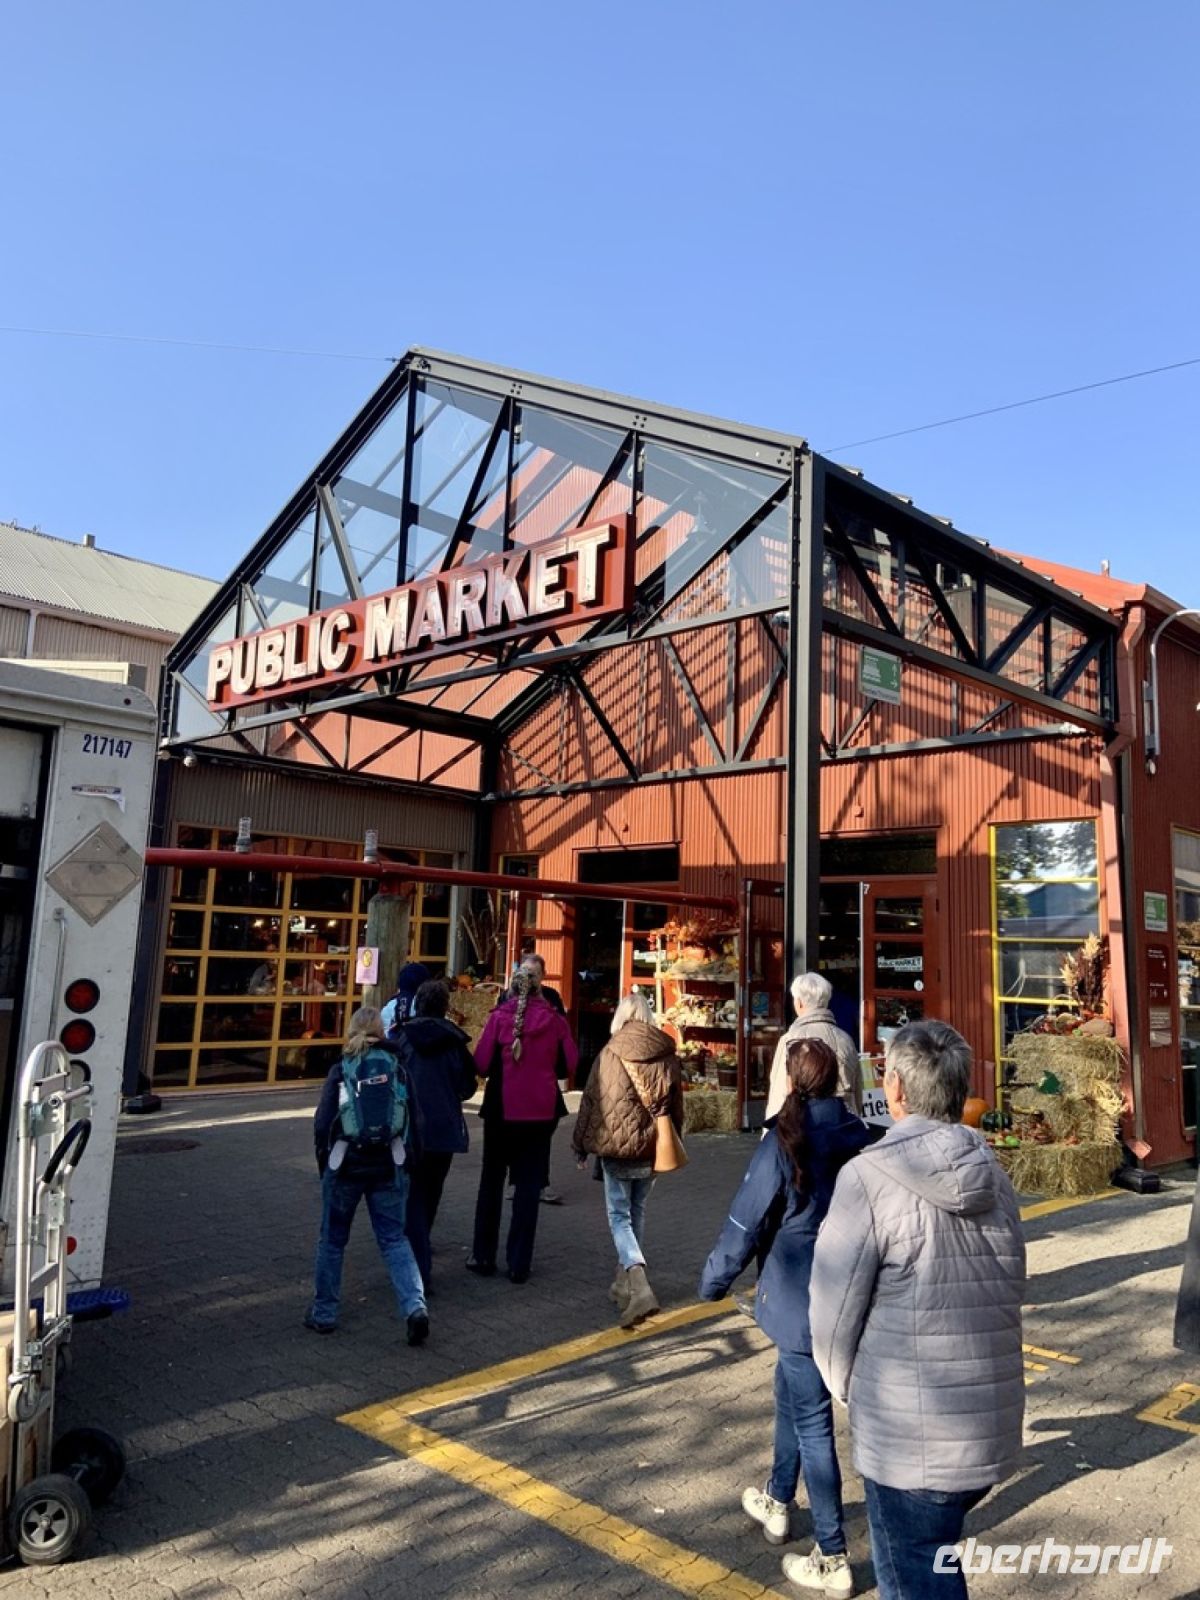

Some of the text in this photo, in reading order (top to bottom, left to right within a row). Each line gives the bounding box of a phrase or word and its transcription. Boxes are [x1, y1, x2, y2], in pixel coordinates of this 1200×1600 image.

[207, 523, 614, 701] PUBLIC MARKET
[82, 733, 132, 759] 217147
[863, 884, 870, 895] 7
